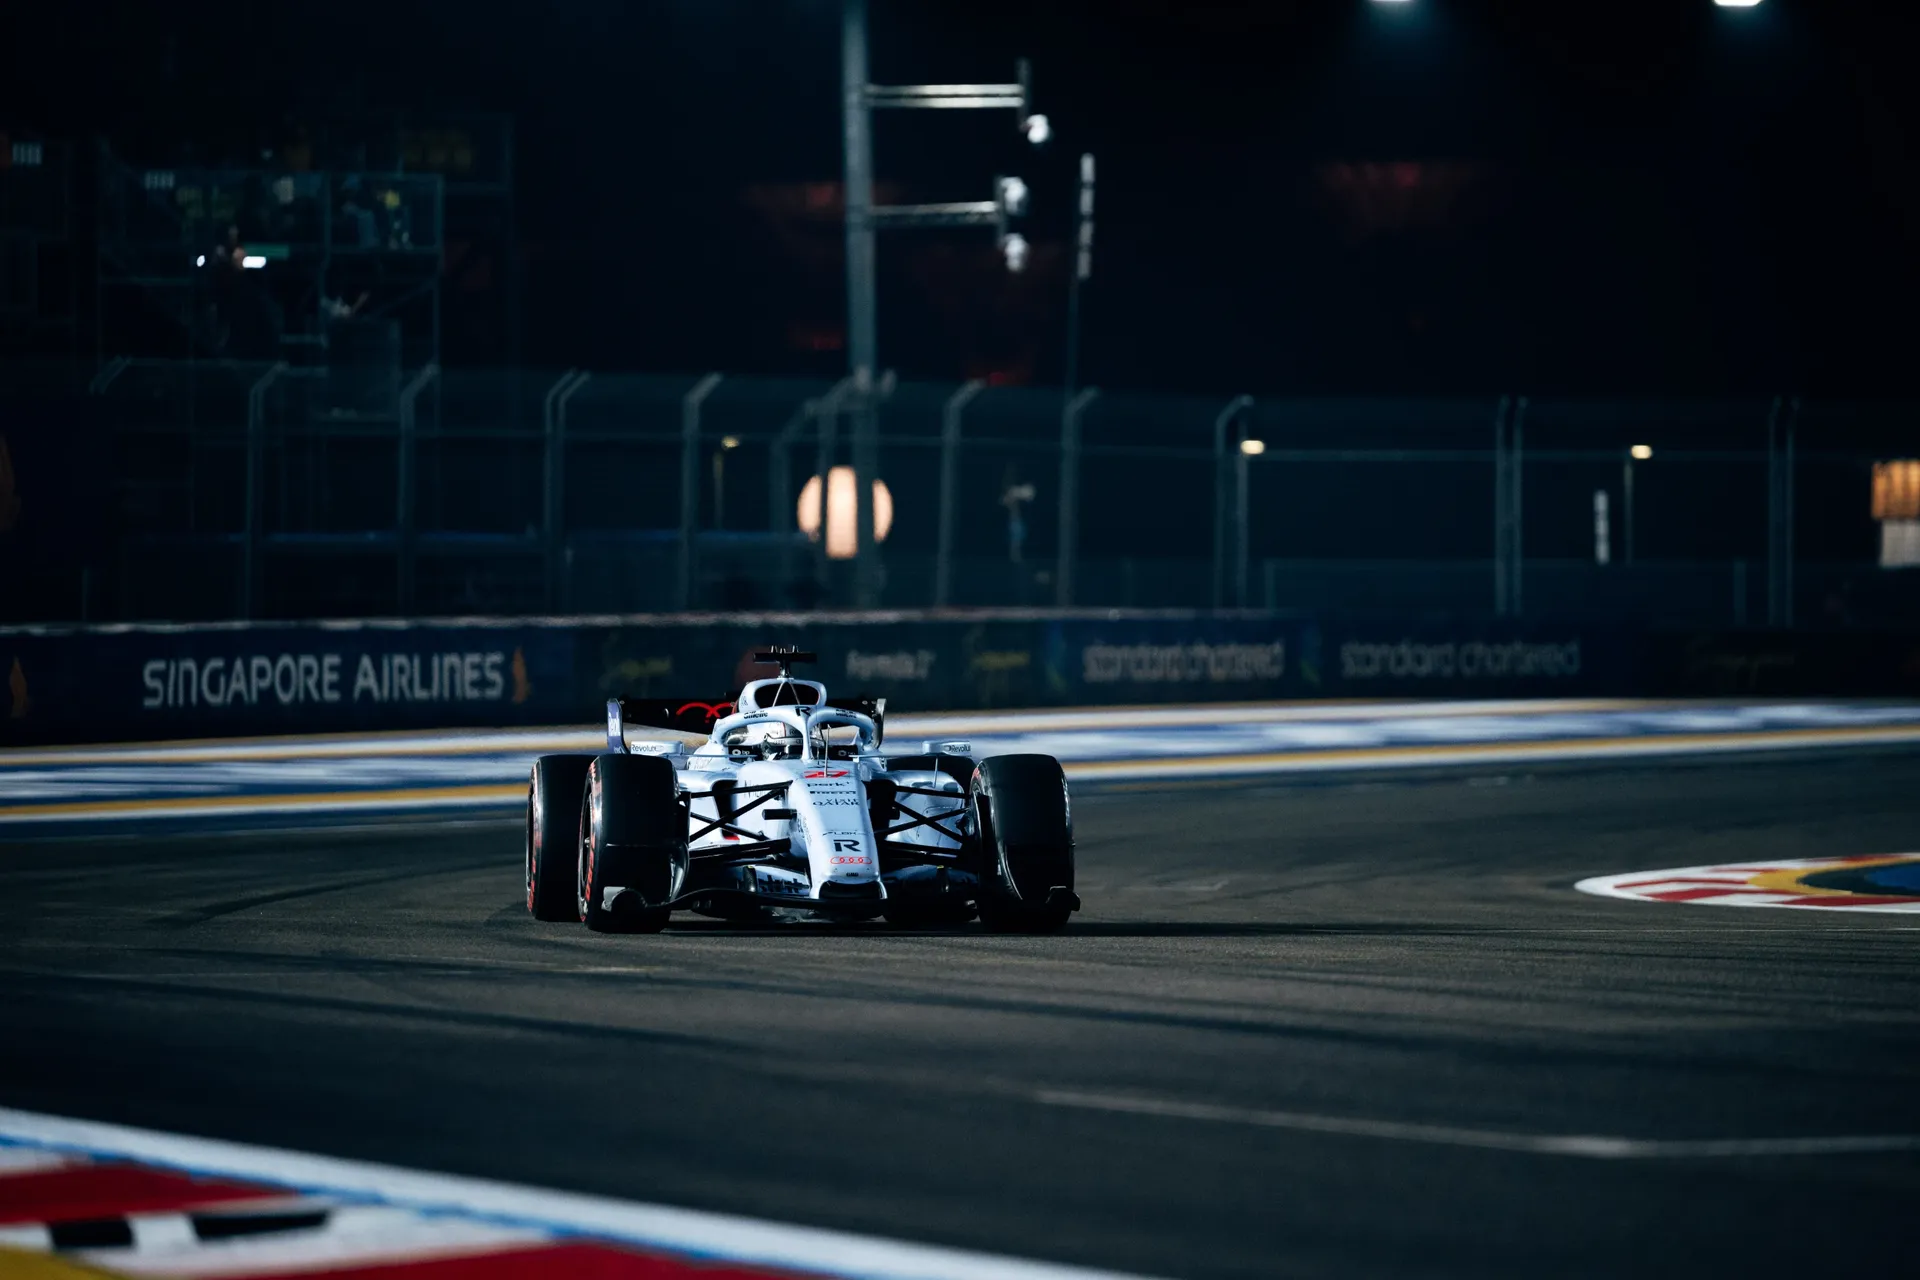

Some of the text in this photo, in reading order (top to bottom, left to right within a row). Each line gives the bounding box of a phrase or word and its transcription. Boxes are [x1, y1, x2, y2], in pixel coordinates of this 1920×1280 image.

[143, 652, 505, 708] SINGAPORE AIRLINES
[833, 839, 862, 852] R
